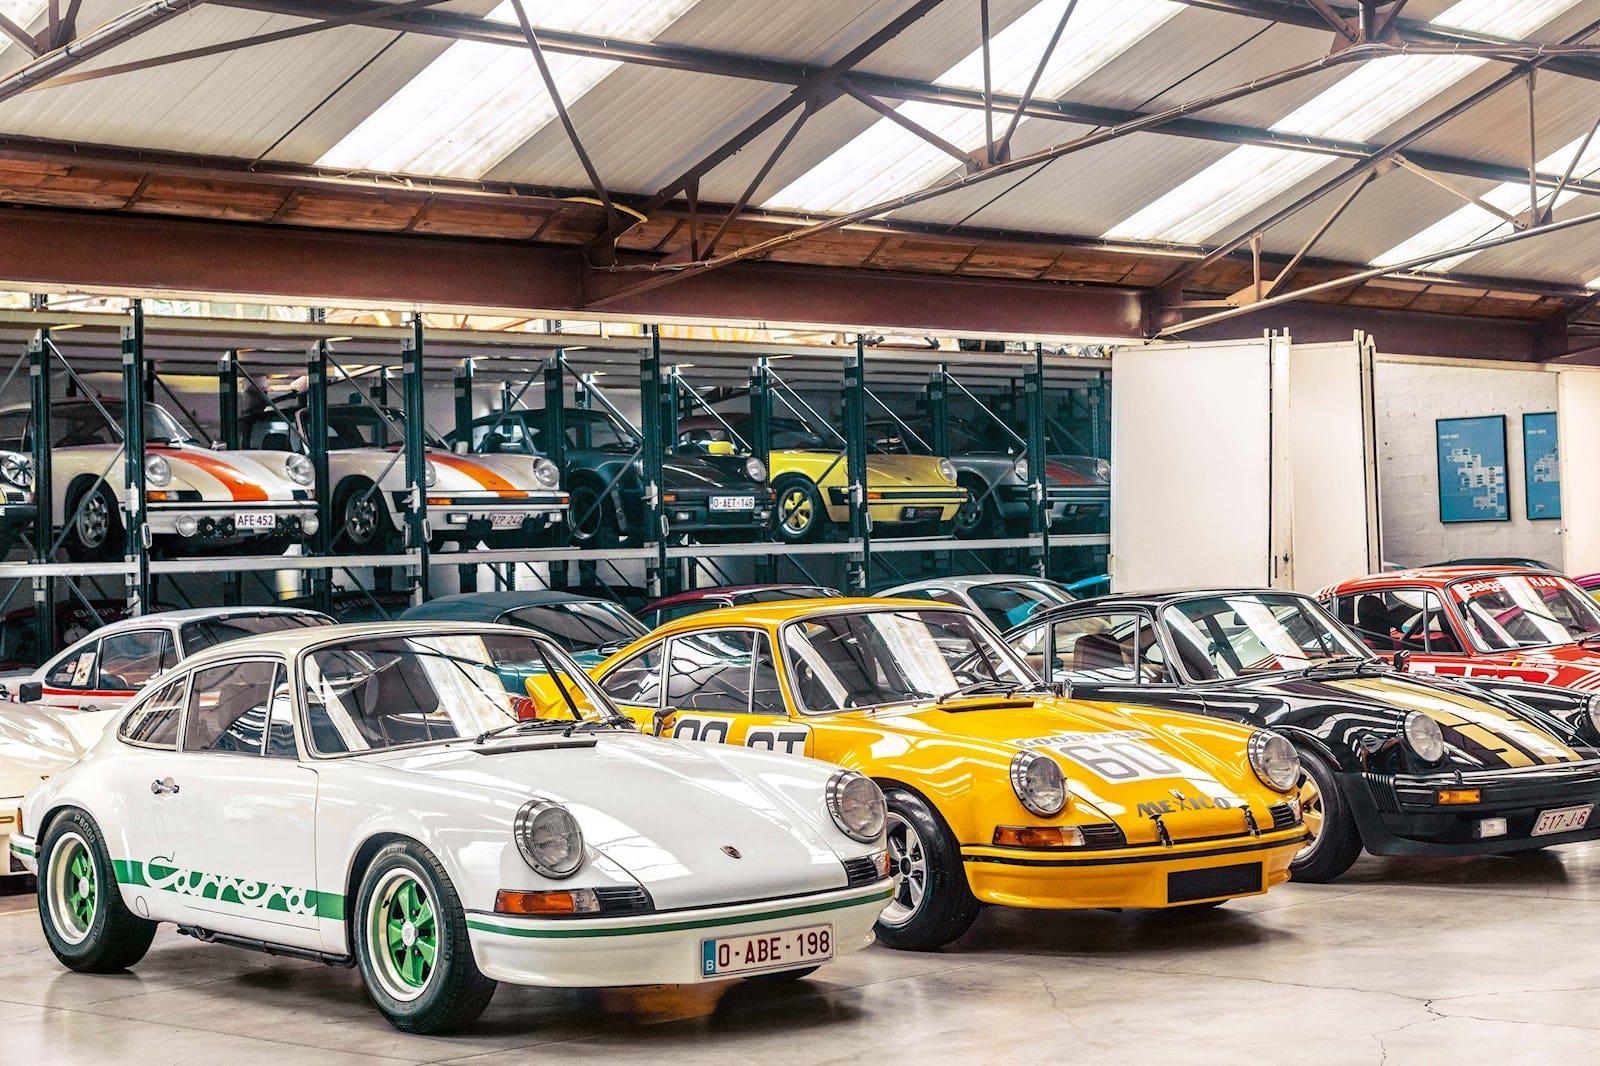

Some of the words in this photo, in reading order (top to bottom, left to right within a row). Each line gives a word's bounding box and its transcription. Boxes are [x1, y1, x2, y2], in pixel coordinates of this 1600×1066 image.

[237, 515, 255, 526] AFE
[256, 515, 273, 526] 452
[1528, 577, 1558, 588] RAS
[1015, 731, 1143, 747] GOODYEAR
[1059, 742, 1182, 780] 60
[1137, 796, 1232, 818] MEXICO
[142, 851, 318, 917] Carrera
[706, 960, 714, 970] B
